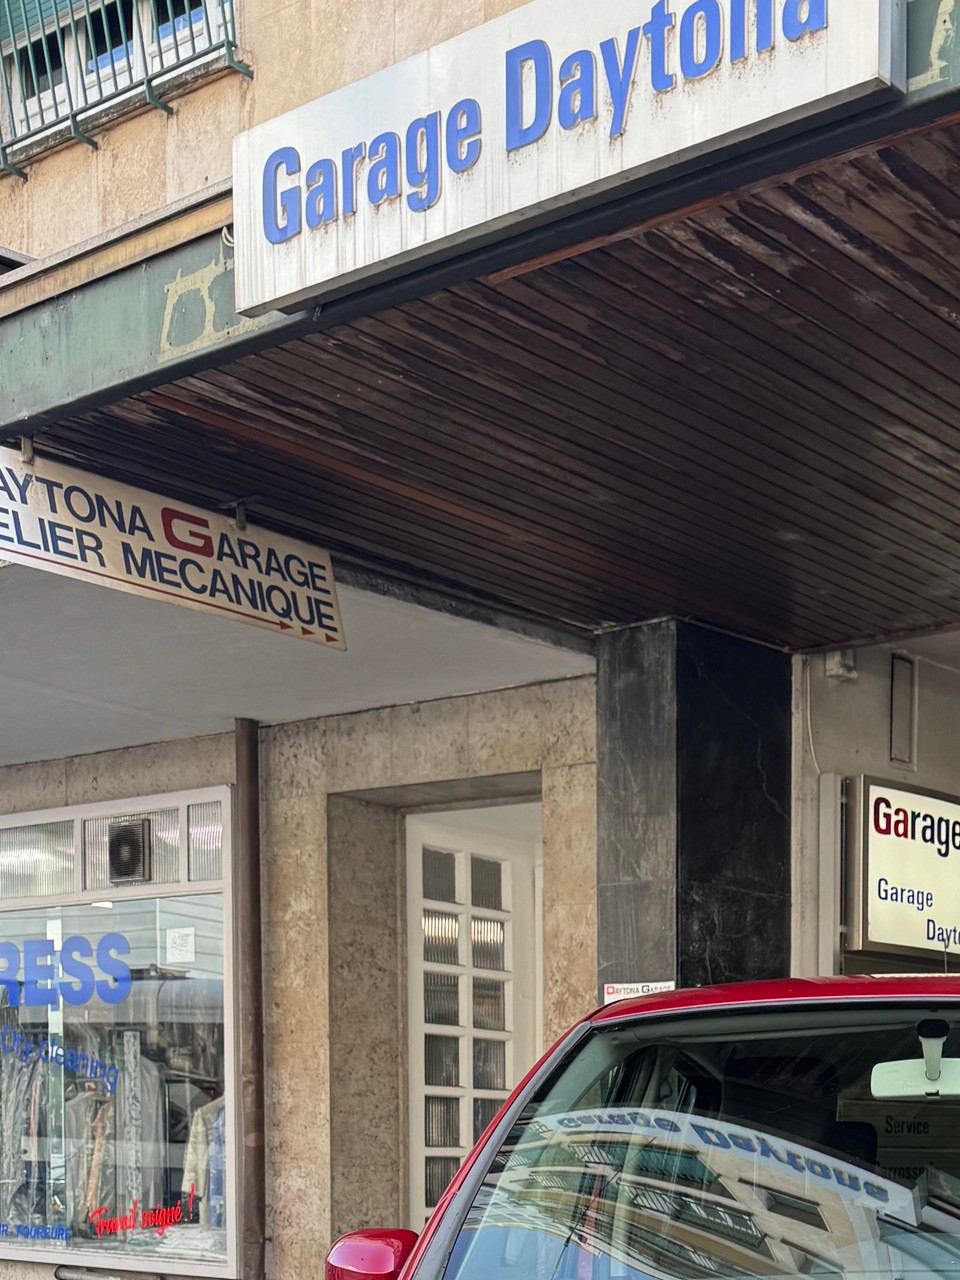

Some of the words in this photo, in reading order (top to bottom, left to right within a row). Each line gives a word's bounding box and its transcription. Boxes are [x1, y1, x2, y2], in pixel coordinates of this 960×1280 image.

[262, 97, 483, 246] Garage
[161, 507, 331, 595] GARAGE
[121, 541, 338, 633] MECANIQUE
[877, 878, 933, 911] Garage
[606, 985, 640, 995] DAYTONA
[0, 1025, 34, 1062] Dry
[38, 1037, 120, 1095] cleaning
[885, 1115, 930, 1135] Service
